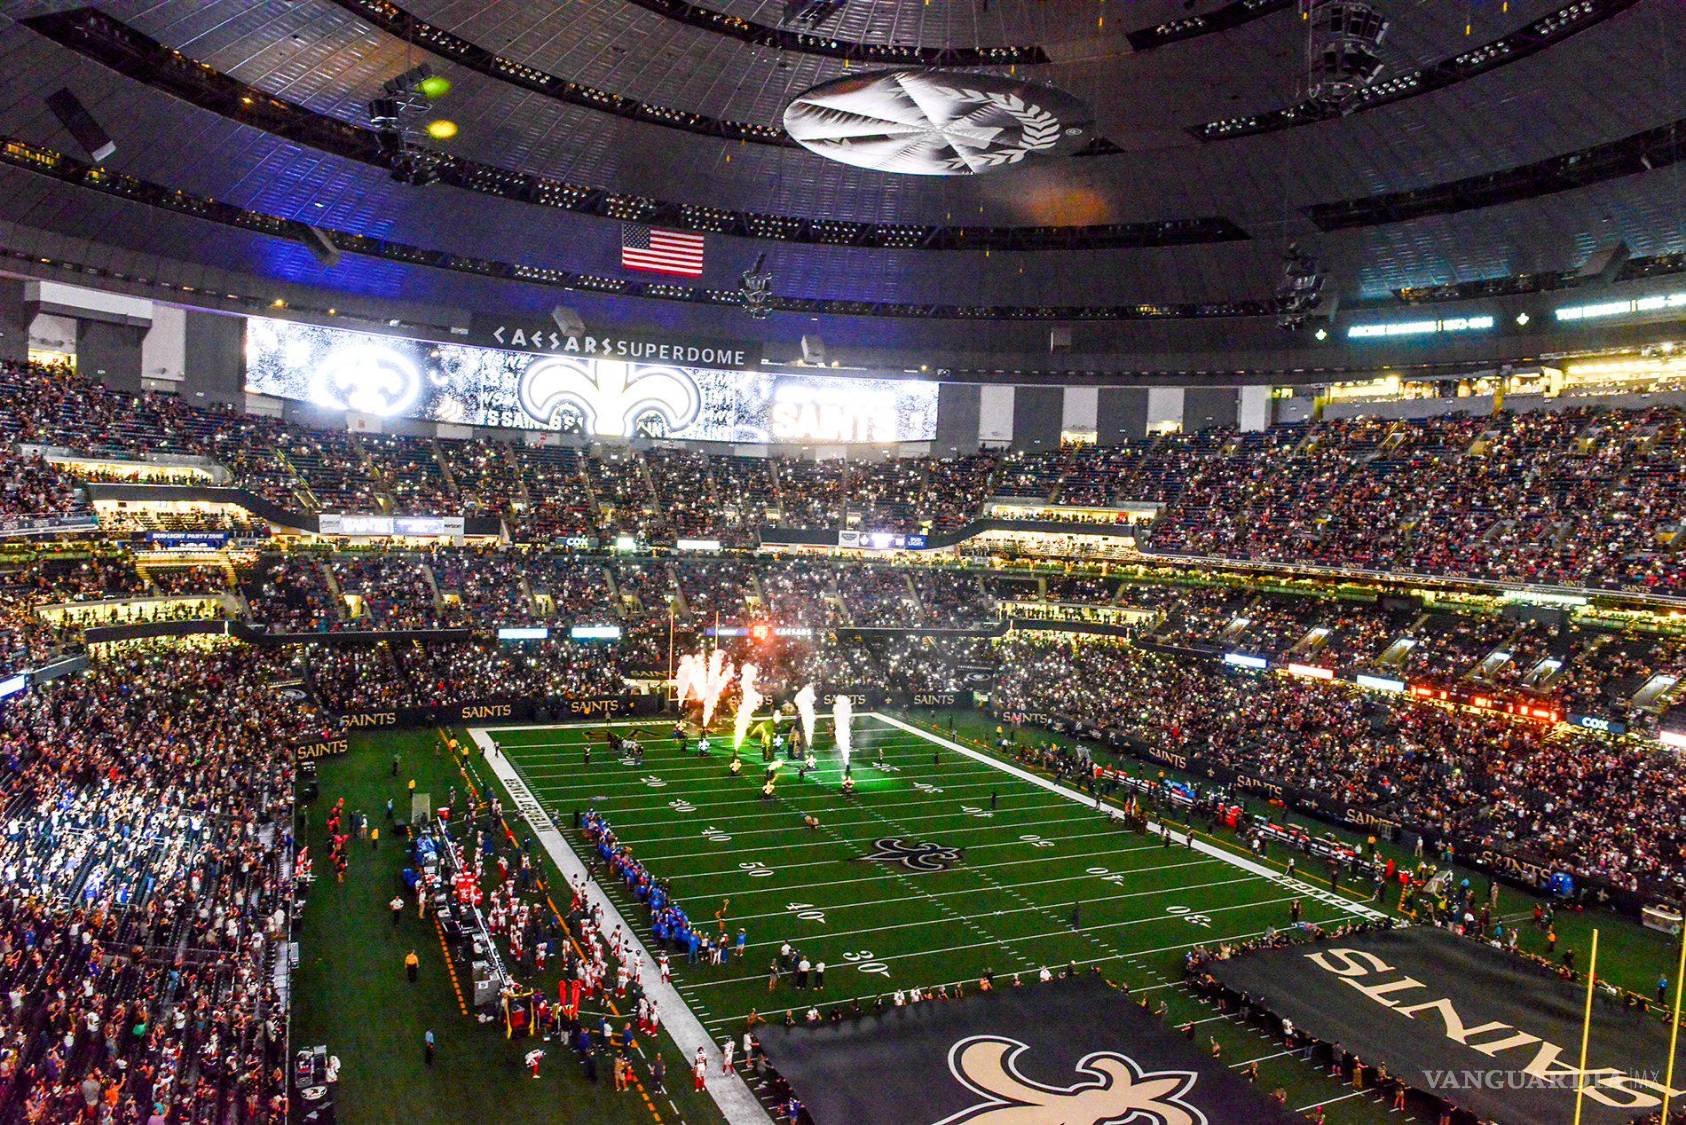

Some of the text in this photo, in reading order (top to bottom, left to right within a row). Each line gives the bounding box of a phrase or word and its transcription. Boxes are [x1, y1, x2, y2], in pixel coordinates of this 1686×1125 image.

[493, 326, 745, 365] CAESARS SUPERDOME
[566, 537, 589, 546] COX
[571, 700, 619, 713] SAINTS
[824, 694, 866, 705] SATS
[914, 694, 955, 705] SAINTS
[462, 704, 512, 719] SAINTS
[1002, 711, 1047, 724] SAINTS
[340, 712, 396, 727] SAINTS
[1582, 717, 1609, 731] COX
[297, 739, 348, 760] SAINTS
[1149, 747, 1187, 769] SAINTS
[701, 828, 732, 841] 40
[1019, 834, 1055, 848] 50
[739, 862, 774, 877] 50
[1086, 867, 1124, 882] 40
[786, 902, 824, 920] 40
[1166, 905, 1212, 924] 30
[843, 950, 888, 973] 30
[1304, 948, 1686, 1108] SAINTS
